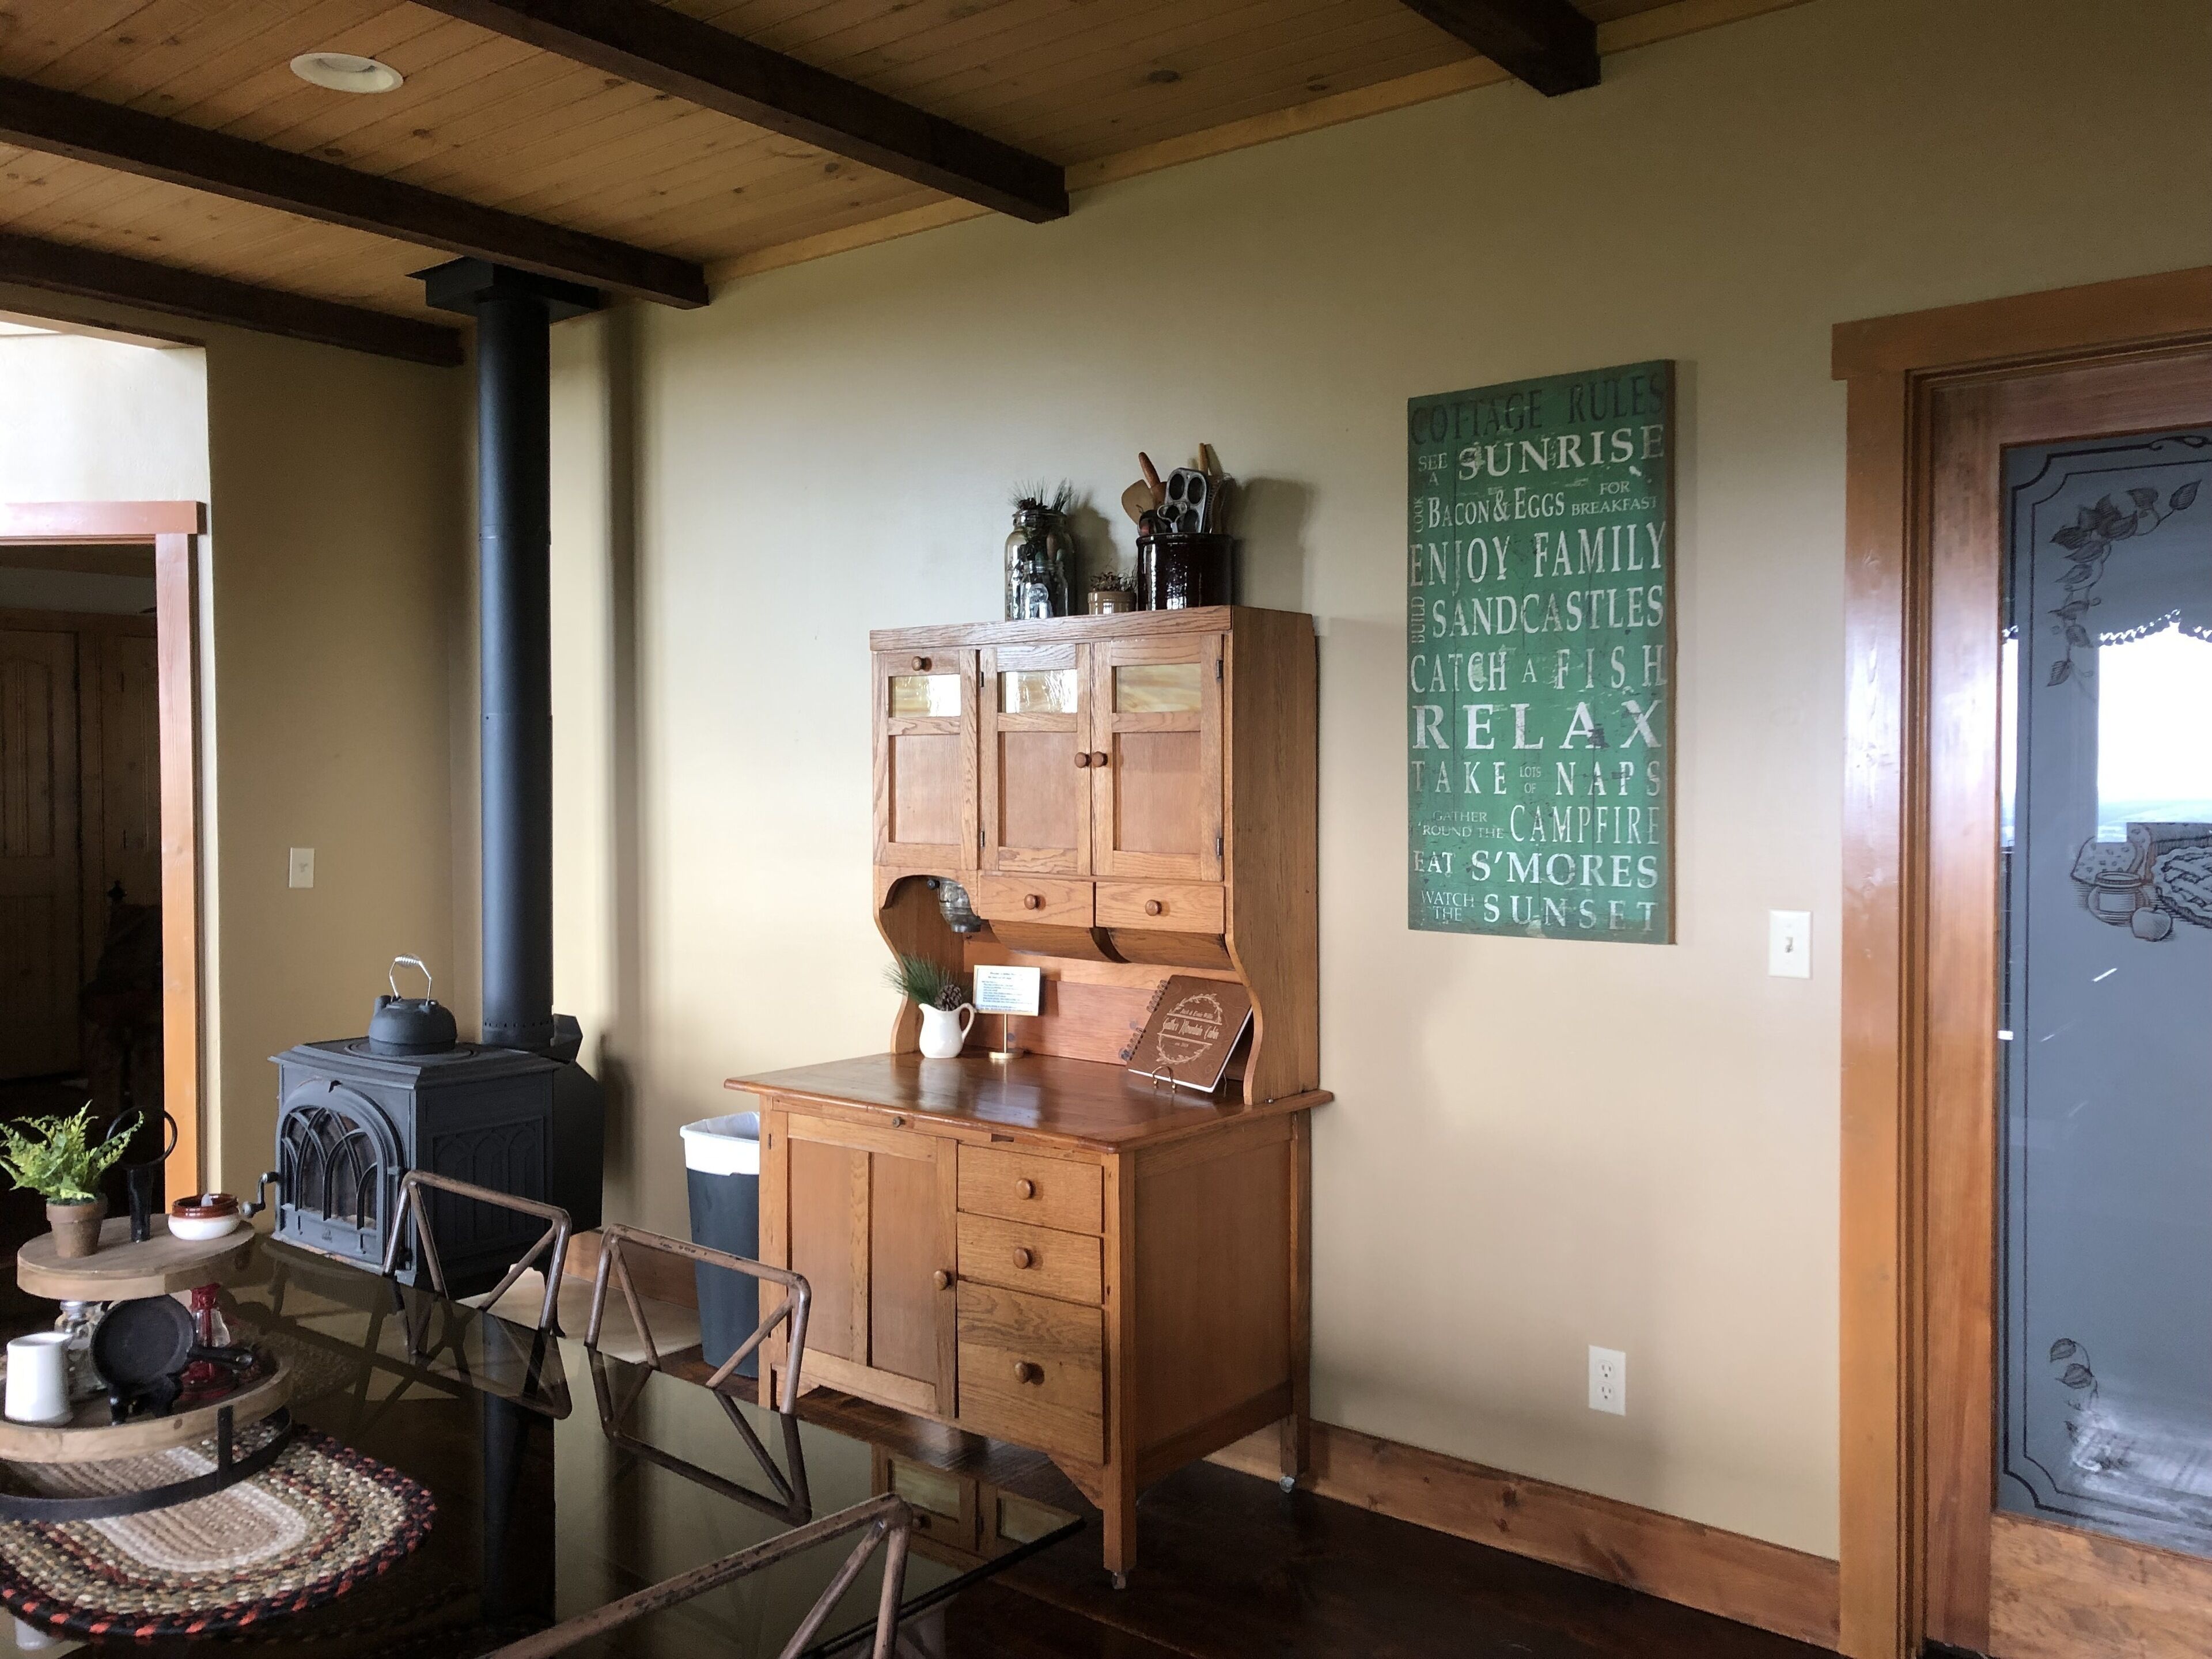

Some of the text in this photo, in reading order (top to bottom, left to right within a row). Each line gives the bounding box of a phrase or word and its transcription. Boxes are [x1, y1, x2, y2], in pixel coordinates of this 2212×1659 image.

[1411, 373, 1664, 445] COTTAGE RULES
[1418, 452, 1447, 472] SEE
[1459, 424, 1664, 480] SUNRISE
[1429, 472, 1439, 486] A
[1599, 480, 1630, 495] FOR
[1414, 496, 1423, 533] COOK
[1571, 495, 1657, 516] BREAKFAST
[1410, 521, 1666, 597] ENJOY FAMILY
[1411, 596, 1425, 643] BUILD
[1433, 585, 1664, 639] SANDCASTLES
[1411, 645, 1668, 693] CATCH A FISH
[1412, 699, 1664, 751] RELAX
[1411, 761, 1507, 795] TAKE
[1520, 766, 1541, 778] LOTS
[1524, 783, 1536, 794] OF
[1556, 761, 1660, 797] NAPS
[1433, 810, 1487, 823] GATHER
[1477, 827, 1504, 839] THE
[1510, 805, 1660, 844] CAMPFIRE
[1413, 850, 1658, 888] EAT S'MORES
[1421, 891, 1475, 908] WATCH
[1433, 906, 1462, 921] THE
[1484, 893, 1657, 931] SUNSET
